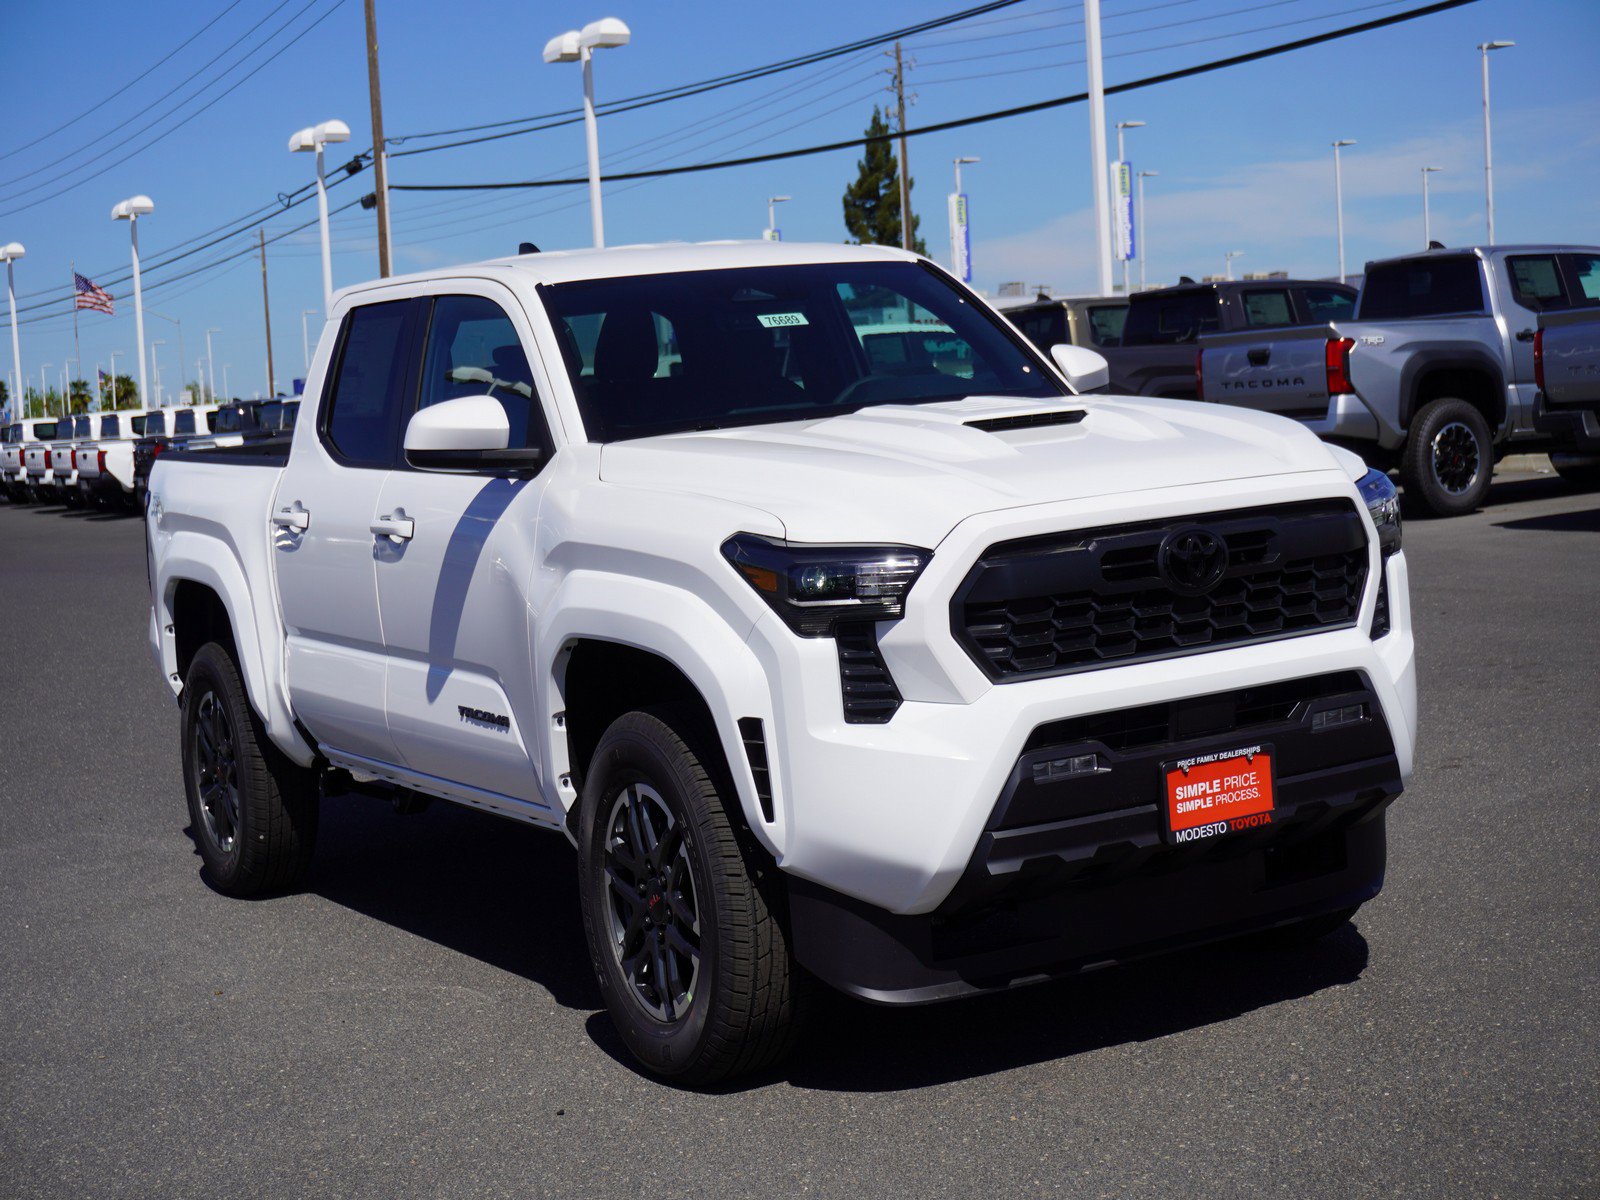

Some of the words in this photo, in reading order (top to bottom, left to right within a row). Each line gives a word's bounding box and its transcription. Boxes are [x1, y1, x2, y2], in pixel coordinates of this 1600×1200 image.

[764, 315, 800, 325] 76689
[1221, 377, 1305, 389] TACOMA
[1177, 758, 1195, 768] PRICE
[1196, 754, 1219, 765] FAMILY
[1219, 745, 1261, 760] DEALERSHIPS
[1175, 779, 1221, 800] SIMPLE
[1223, 771, 1260, 790] PRICE.
[1176, 797, 1213, 814] SIMPLE
[1215, 787, 1261, 806] PROCESS.
[1175, 821, 1227, 843] MODESTO
[1229, 813, 1272, 831] TOYOTA
